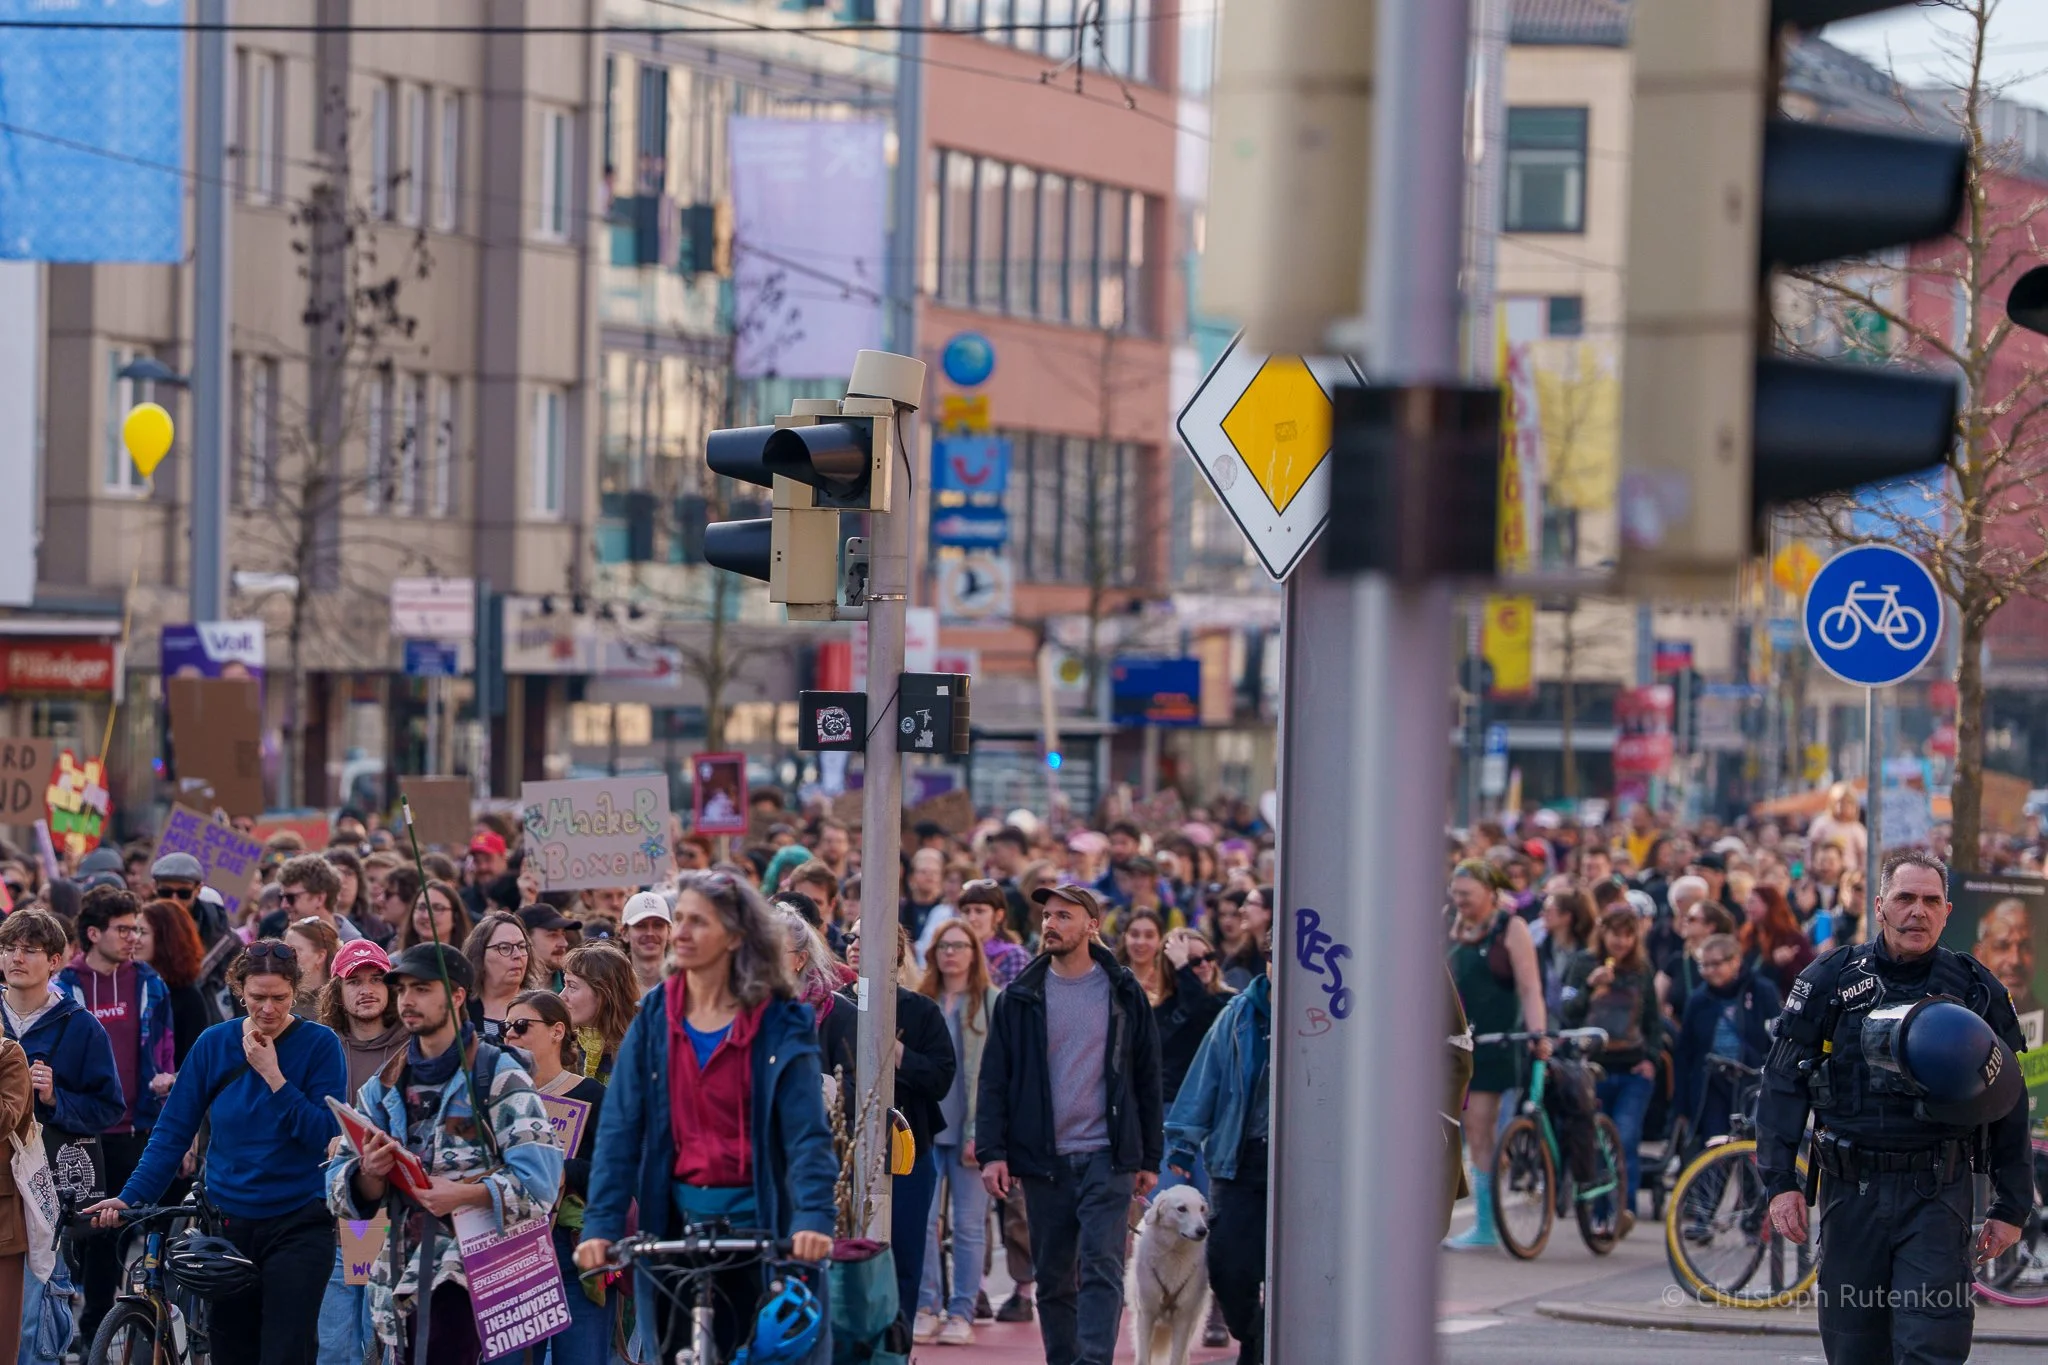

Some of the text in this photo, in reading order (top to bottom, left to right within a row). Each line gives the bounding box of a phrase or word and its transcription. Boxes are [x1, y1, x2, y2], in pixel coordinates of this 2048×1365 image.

[170, 809, 202, 835] DIE
[204, 822, 262, 863] SCHAM
[216, 850, 247, 877] DIE
[1842, 977, 1874, 1002] POLIZEI
[463, 1239, 488, 1256] AKTIV!
[472, 1253, 539, 1291] SOZIALISMUSTAGE
[519, 1276, 560, 1302] KAPITALISMUS
[485, 1287, 560, 1334] BEKÄMPFEN!
[485, 1303, 568, 1357] SEXISMUS
